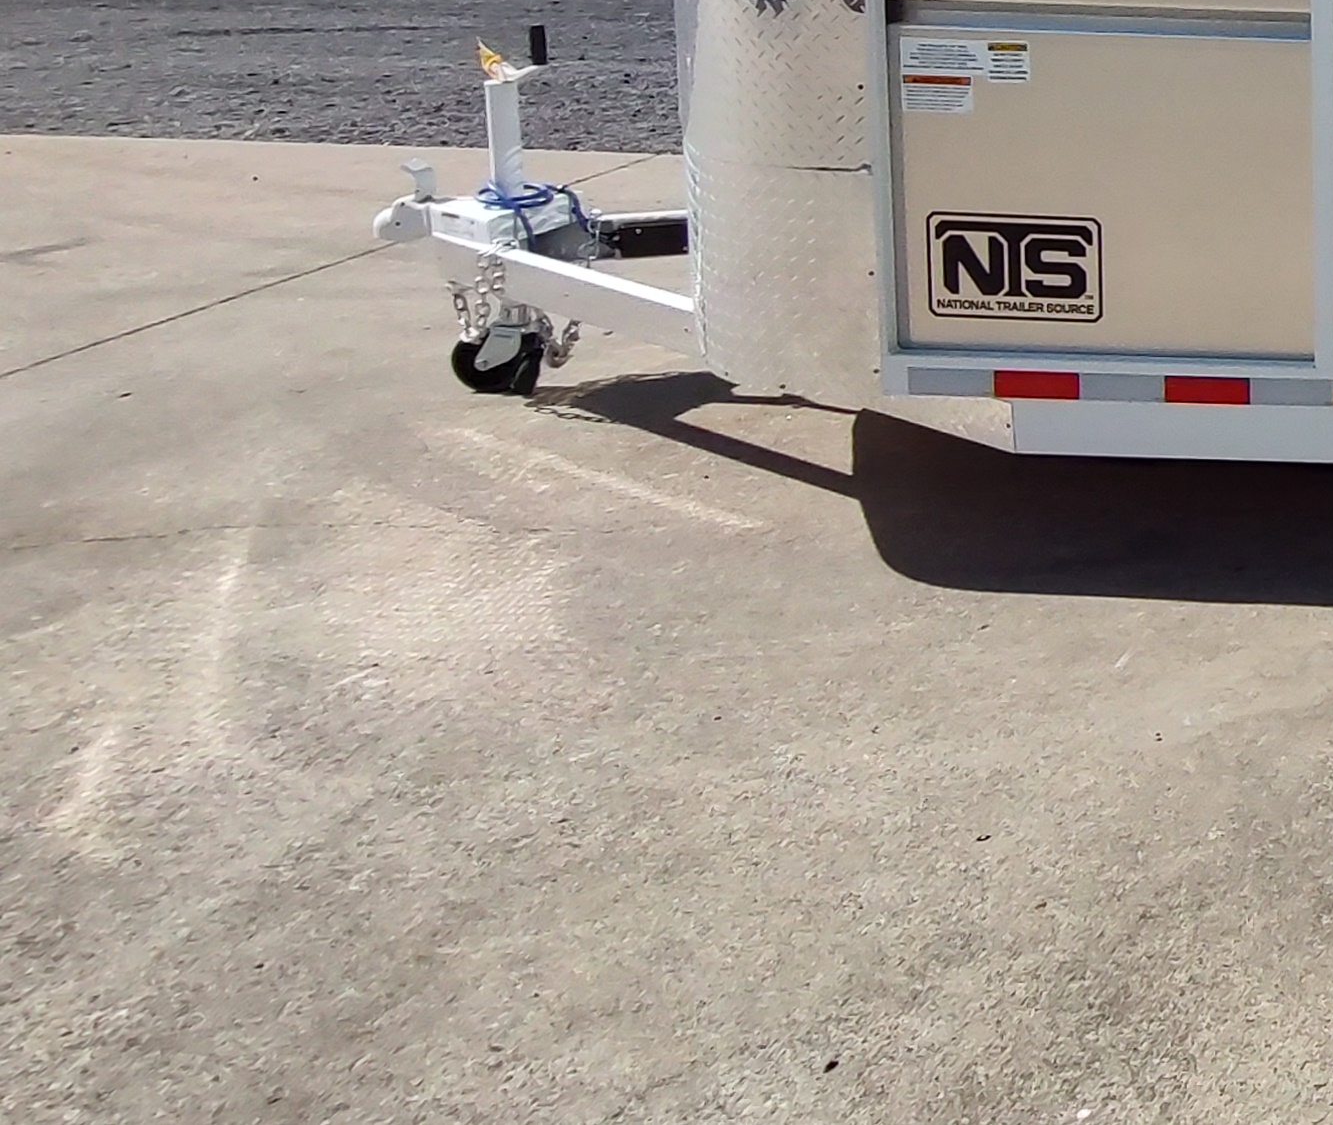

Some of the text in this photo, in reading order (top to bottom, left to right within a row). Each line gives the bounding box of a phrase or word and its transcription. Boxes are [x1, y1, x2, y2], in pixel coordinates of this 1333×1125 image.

[935, 220, 1094, 300] NTS
[937, 298, 1095, 315] NATIONAL TRAILER SOURCE
